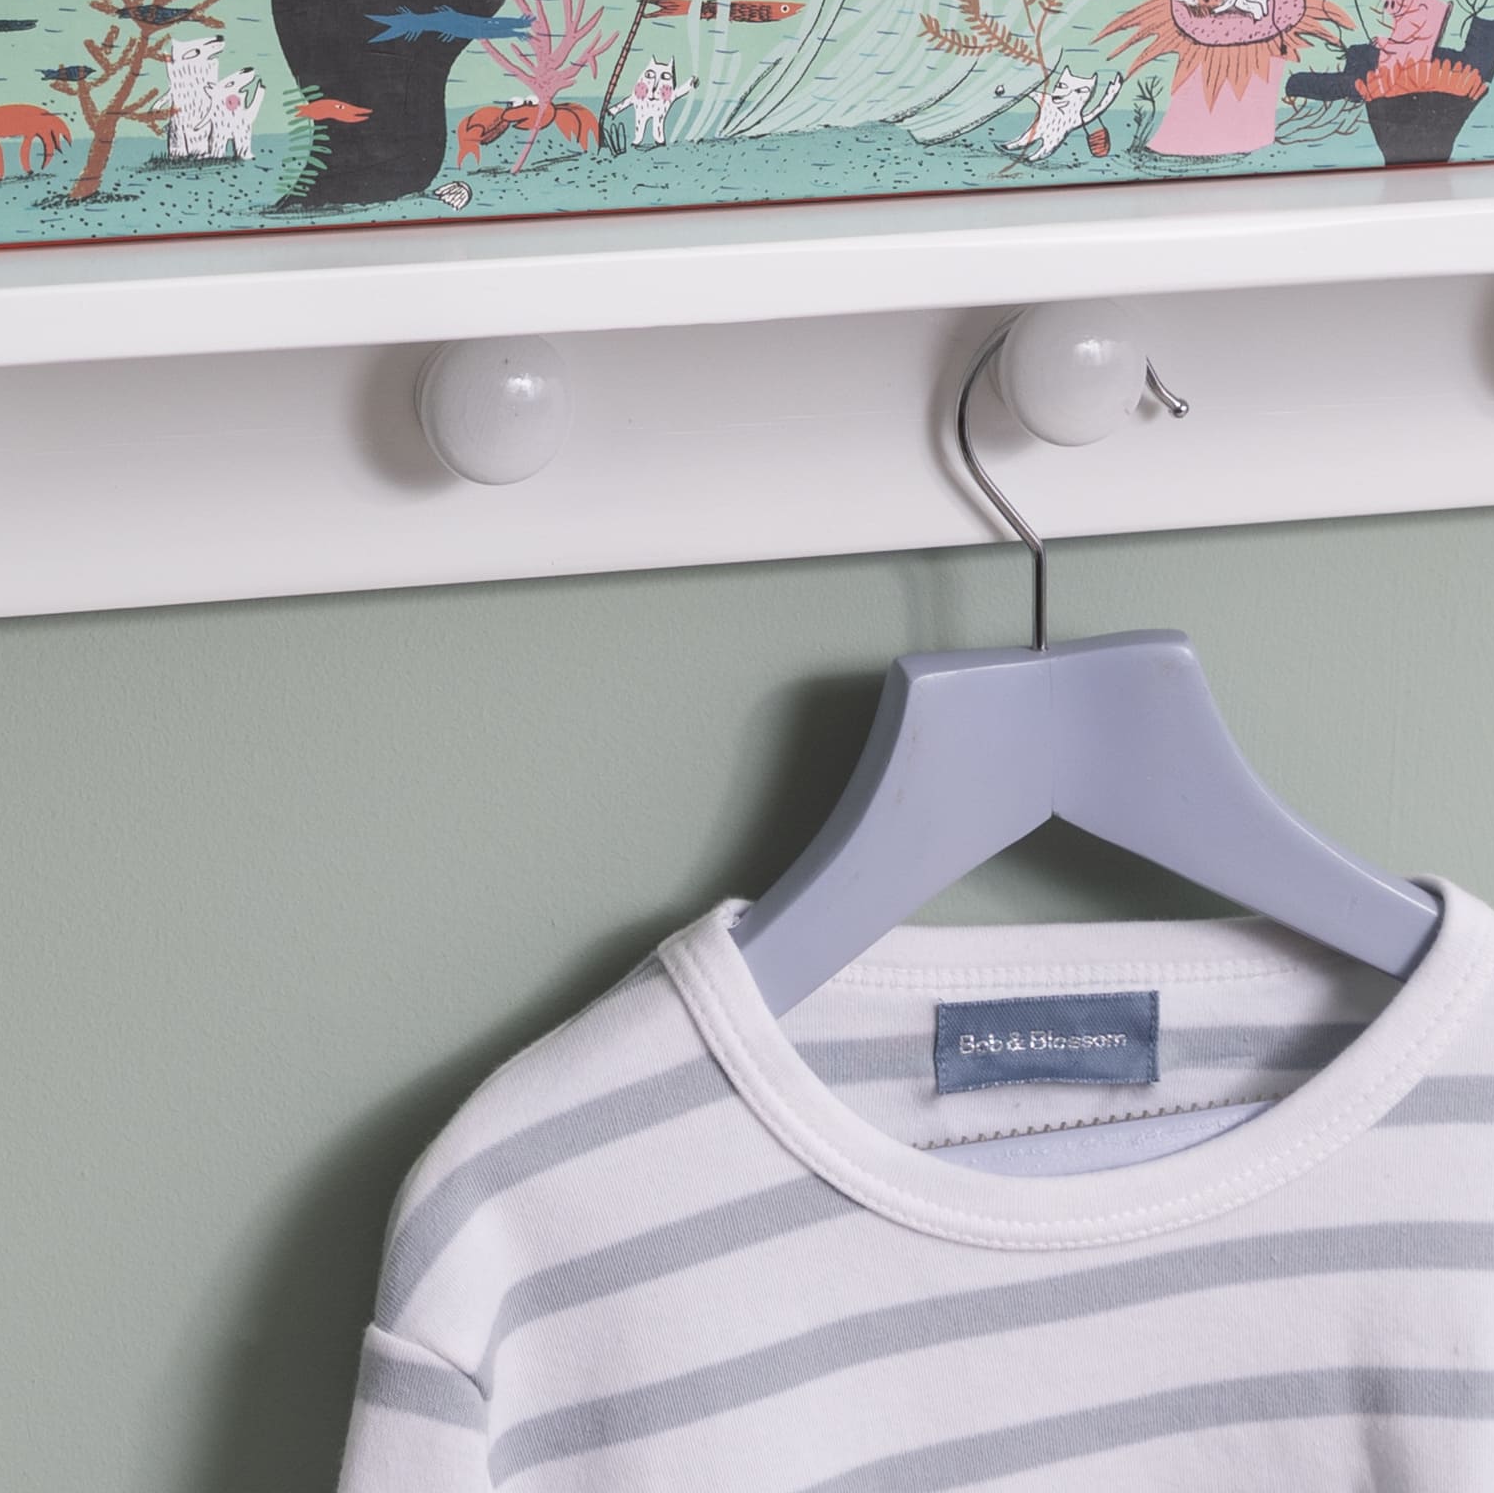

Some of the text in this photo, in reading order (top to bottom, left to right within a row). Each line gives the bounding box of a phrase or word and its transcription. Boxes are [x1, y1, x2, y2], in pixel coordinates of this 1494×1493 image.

[959, 1029, 1128, 1055] Bob & Blossom
